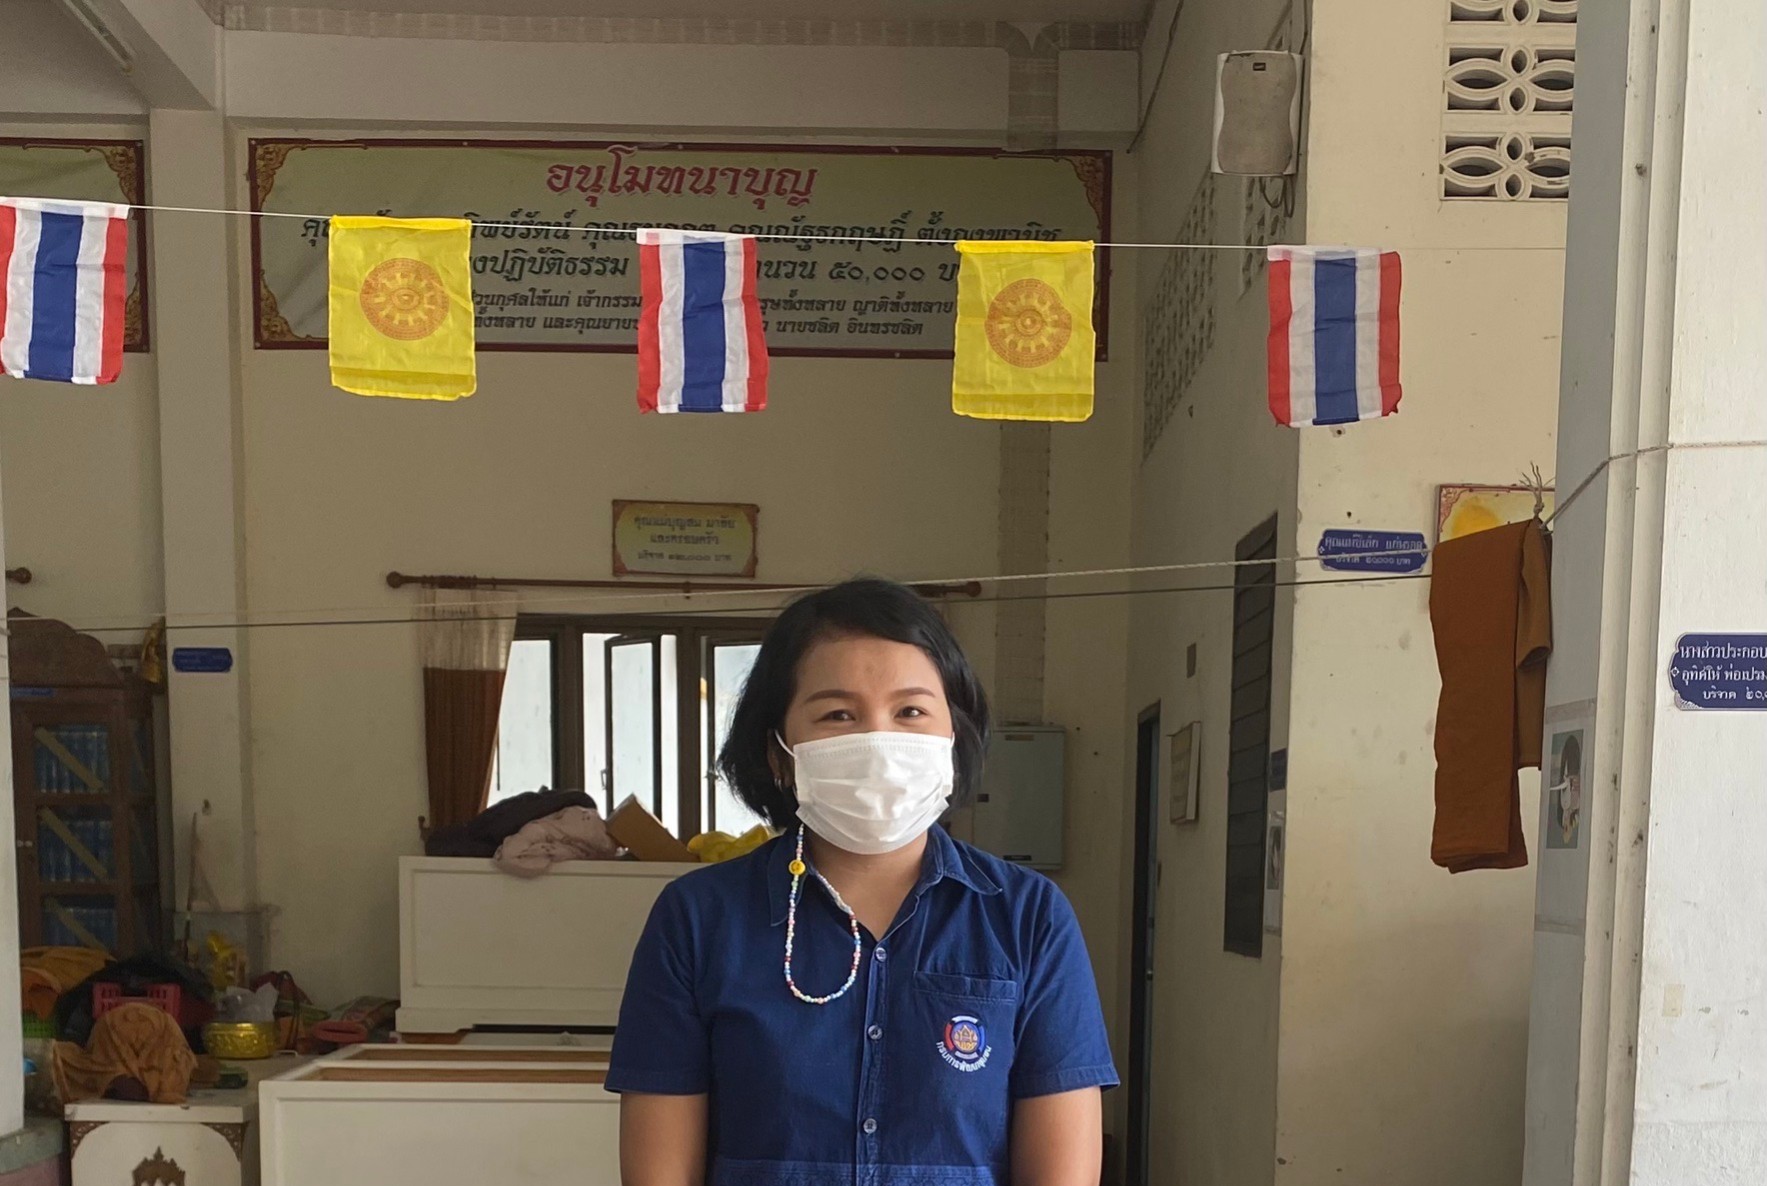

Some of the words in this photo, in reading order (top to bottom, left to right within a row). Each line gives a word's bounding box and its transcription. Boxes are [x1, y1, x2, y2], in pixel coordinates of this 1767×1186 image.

[546, 144, 818, 210] อนุโมทนาบุญ
[469, 247, 630, 282] งปฏิบัติธรรม
[757, 260, 817, 280] นวน
[1703, 685, 1737, 700] บริจาค
